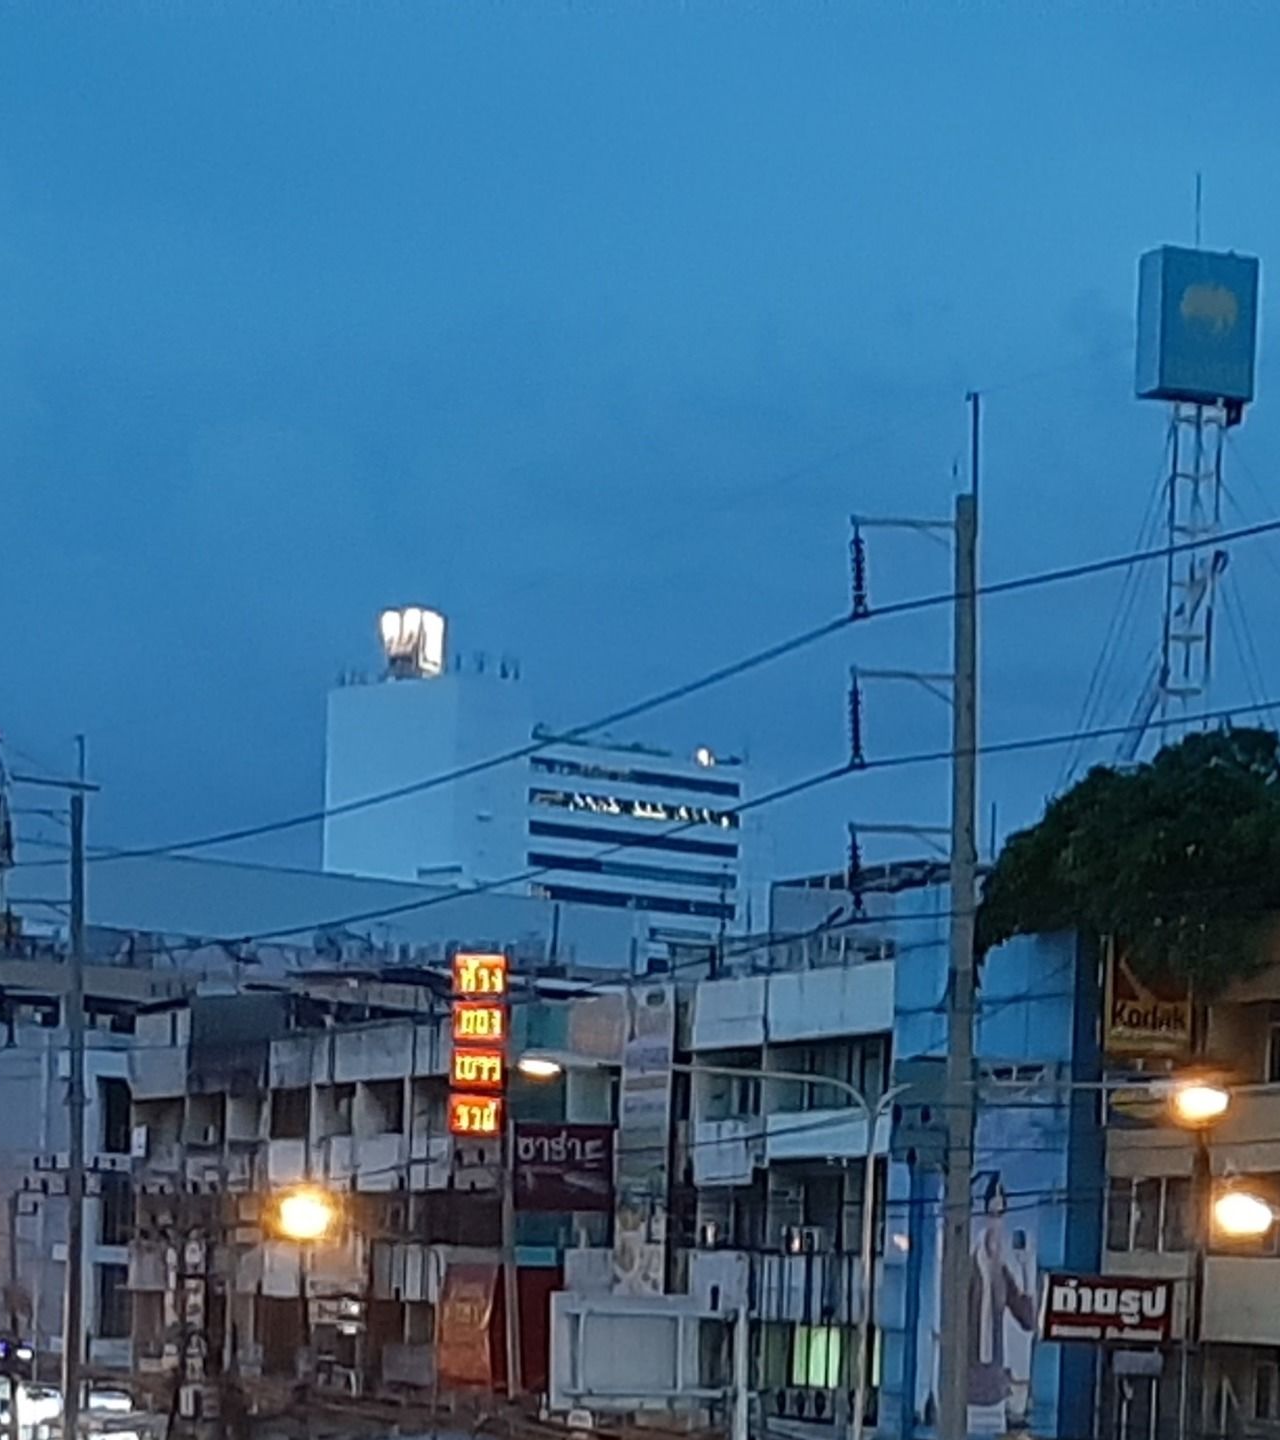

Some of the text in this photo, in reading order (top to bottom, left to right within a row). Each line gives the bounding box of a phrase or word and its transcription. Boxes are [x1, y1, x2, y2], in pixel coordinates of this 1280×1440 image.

[1111, 1002, 1188, 1030] Kodak
[1051, 1279, 1166, 1325] ถ่ายรูป
